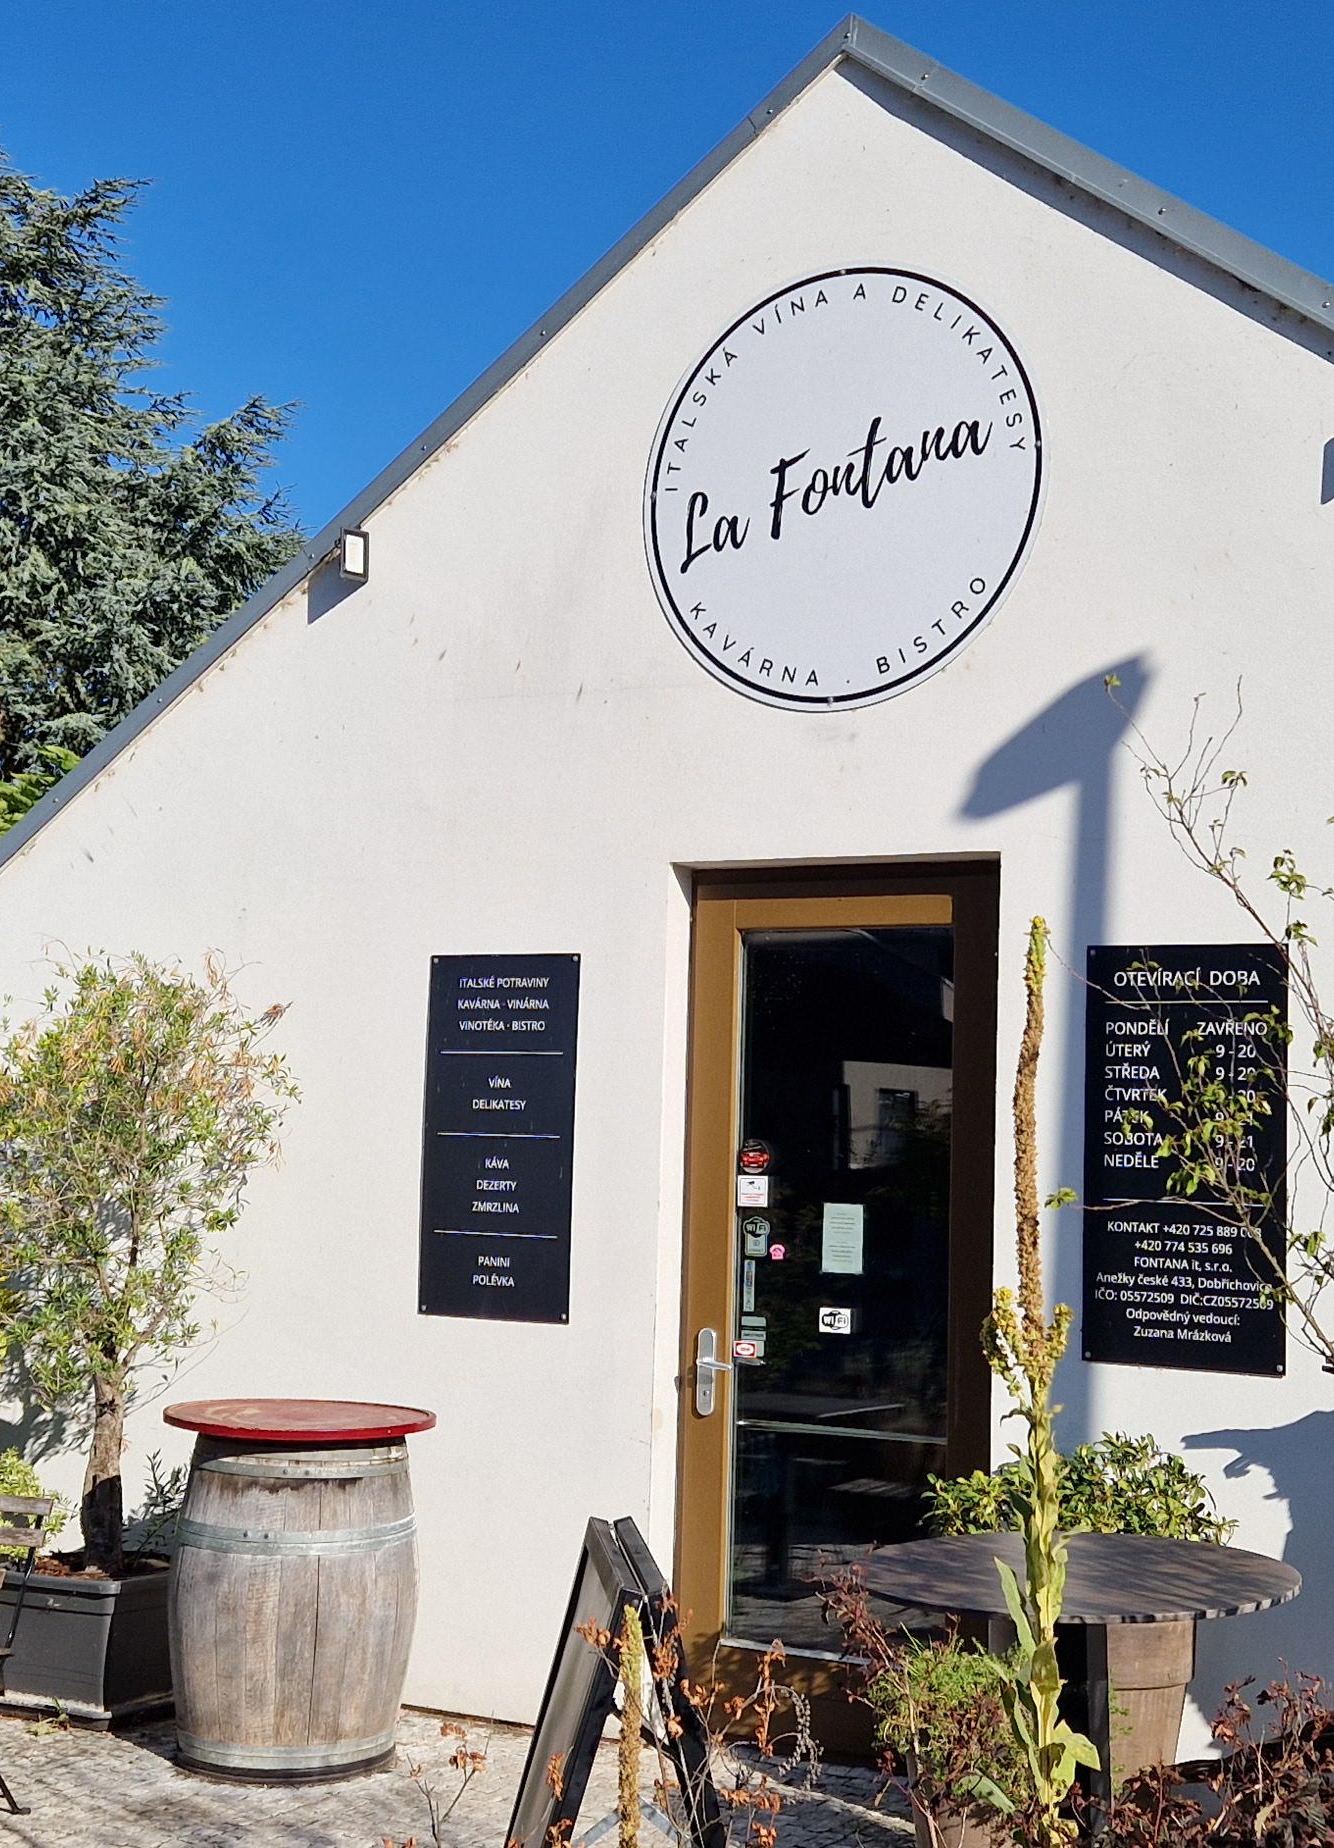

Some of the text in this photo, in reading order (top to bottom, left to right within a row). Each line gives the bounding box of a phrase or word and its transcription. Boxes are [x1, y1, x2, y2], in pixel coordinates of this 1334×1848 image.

[665, 283, 1026, 491] ITALSKÁ VÍNA A DELIKATESY
[679, 416, 993, 574] La Fontana
[689, 601, 820, 687] KAVÁRNA
[875, 577, 987, 675] BISTRO
[459, 975, 550, 989] ITALSKÉ POTRAVINY
[1113, 966, 1261, 987] OTEVÍRACÍ DOBA
[457, 996, 501, 1010] KAVÁRNA
[506, 996, 550, 1010] VINÁRNA
[458, 1018, 505, 1031] VINOTÉKA
[511, 1020, 546, 1031] BISTRO
[1106, 1018, 1268, 1036] PONDĚLÍ ZAVŘENO
[1106, 1041, 1151, 1057] ÚTERÝ
[1215, 1044, 1225, 1058] 9
[1237, 1044, 1256, 1058] 20
[1105, 1062, 1161, 1079] STŘEDA
[1215, 1066, 1225, 1080] 9
[488, 1075, 511, 1089] VÍNA
[1105, 1084, 1168, 1101] ČTVRTEK
[472, 1098, 527, 1111] DELIKATESY
[1104, 1131, 1163, 1146] SOBOTA
[1214, 1134, 1224, 1148] 9
[485, 1155, 510, 1169] KÁVA
[1104, 1151, 1160, 1168] NEDĚLE
[476, 1179, 517, 1192] DEZERTY
[471, 1200, 520, 1214] ZMRZLINA
[1107, 1220, 1160, 1234] KONTAKT
[1162, 1223, 1191, 1236] +420
[1192, 1224, 1214, 1236] 725
[1216, 1225, 1238, 1238] 889
[1134, 1239, 1233, 1255] +420 774 535 696
[478, 1255, 510, 1268] PANINI
[1133, 1256, 1189, 1270] FONTANA
[1204, 1262, 1233, 1273] s.r.o.
[472, 1272, 515, 1287] POLÉVKA
[1096, 1271, 1135, 1287] Anežky
[1137, 1273, 1169, 1287] české
[1170, 1276, 1195, 1289] 433,
[1094, 1286, 1118, 1301] IČO:
[1120, 1289, 1175, 1305] 05572509
[1125, 1307, 1241, 1326] Odpovědný vedoucí:
[1133, 1325, 1232, 1343] Zuzana Mrázková
